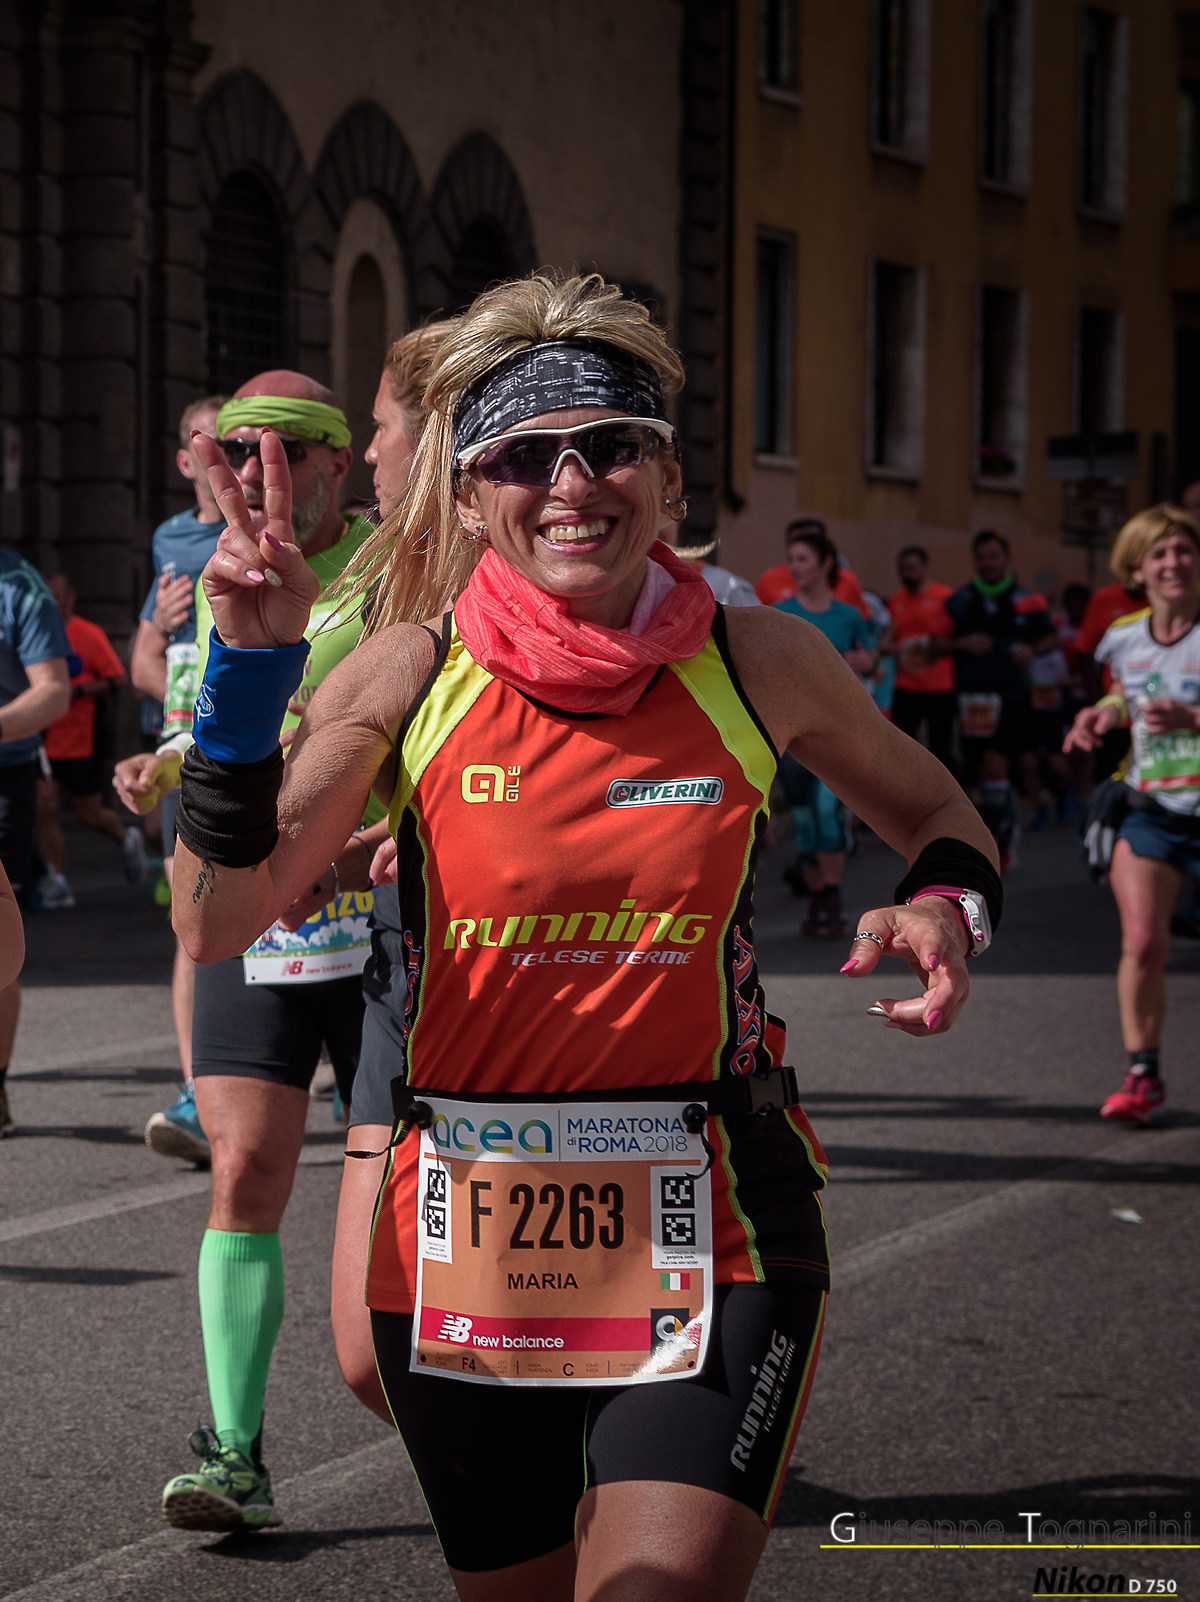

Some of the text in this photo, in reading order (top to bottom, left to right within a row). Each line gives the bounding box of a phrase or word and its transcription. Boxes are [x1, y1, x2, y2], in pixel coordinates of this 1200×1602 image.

[306, 891, 374, 923] 126
[511, 950, 608, 967] TELESE
[433, 1113, 553, 1154] acea
[567, 1118, 686, 1134] MARATONA
[567, 1136, 688, 1153] di ROMA 2018
[470, 1180, 625, 1249] F 2263
[507, 1273, 579, 1290] MARIA
[473, 1335, 498, 1348] new
[502, 1335, 565, 1349] balance
[462, 1357, 477, 1372] F4
[562, 1363, 574, 1377] C
